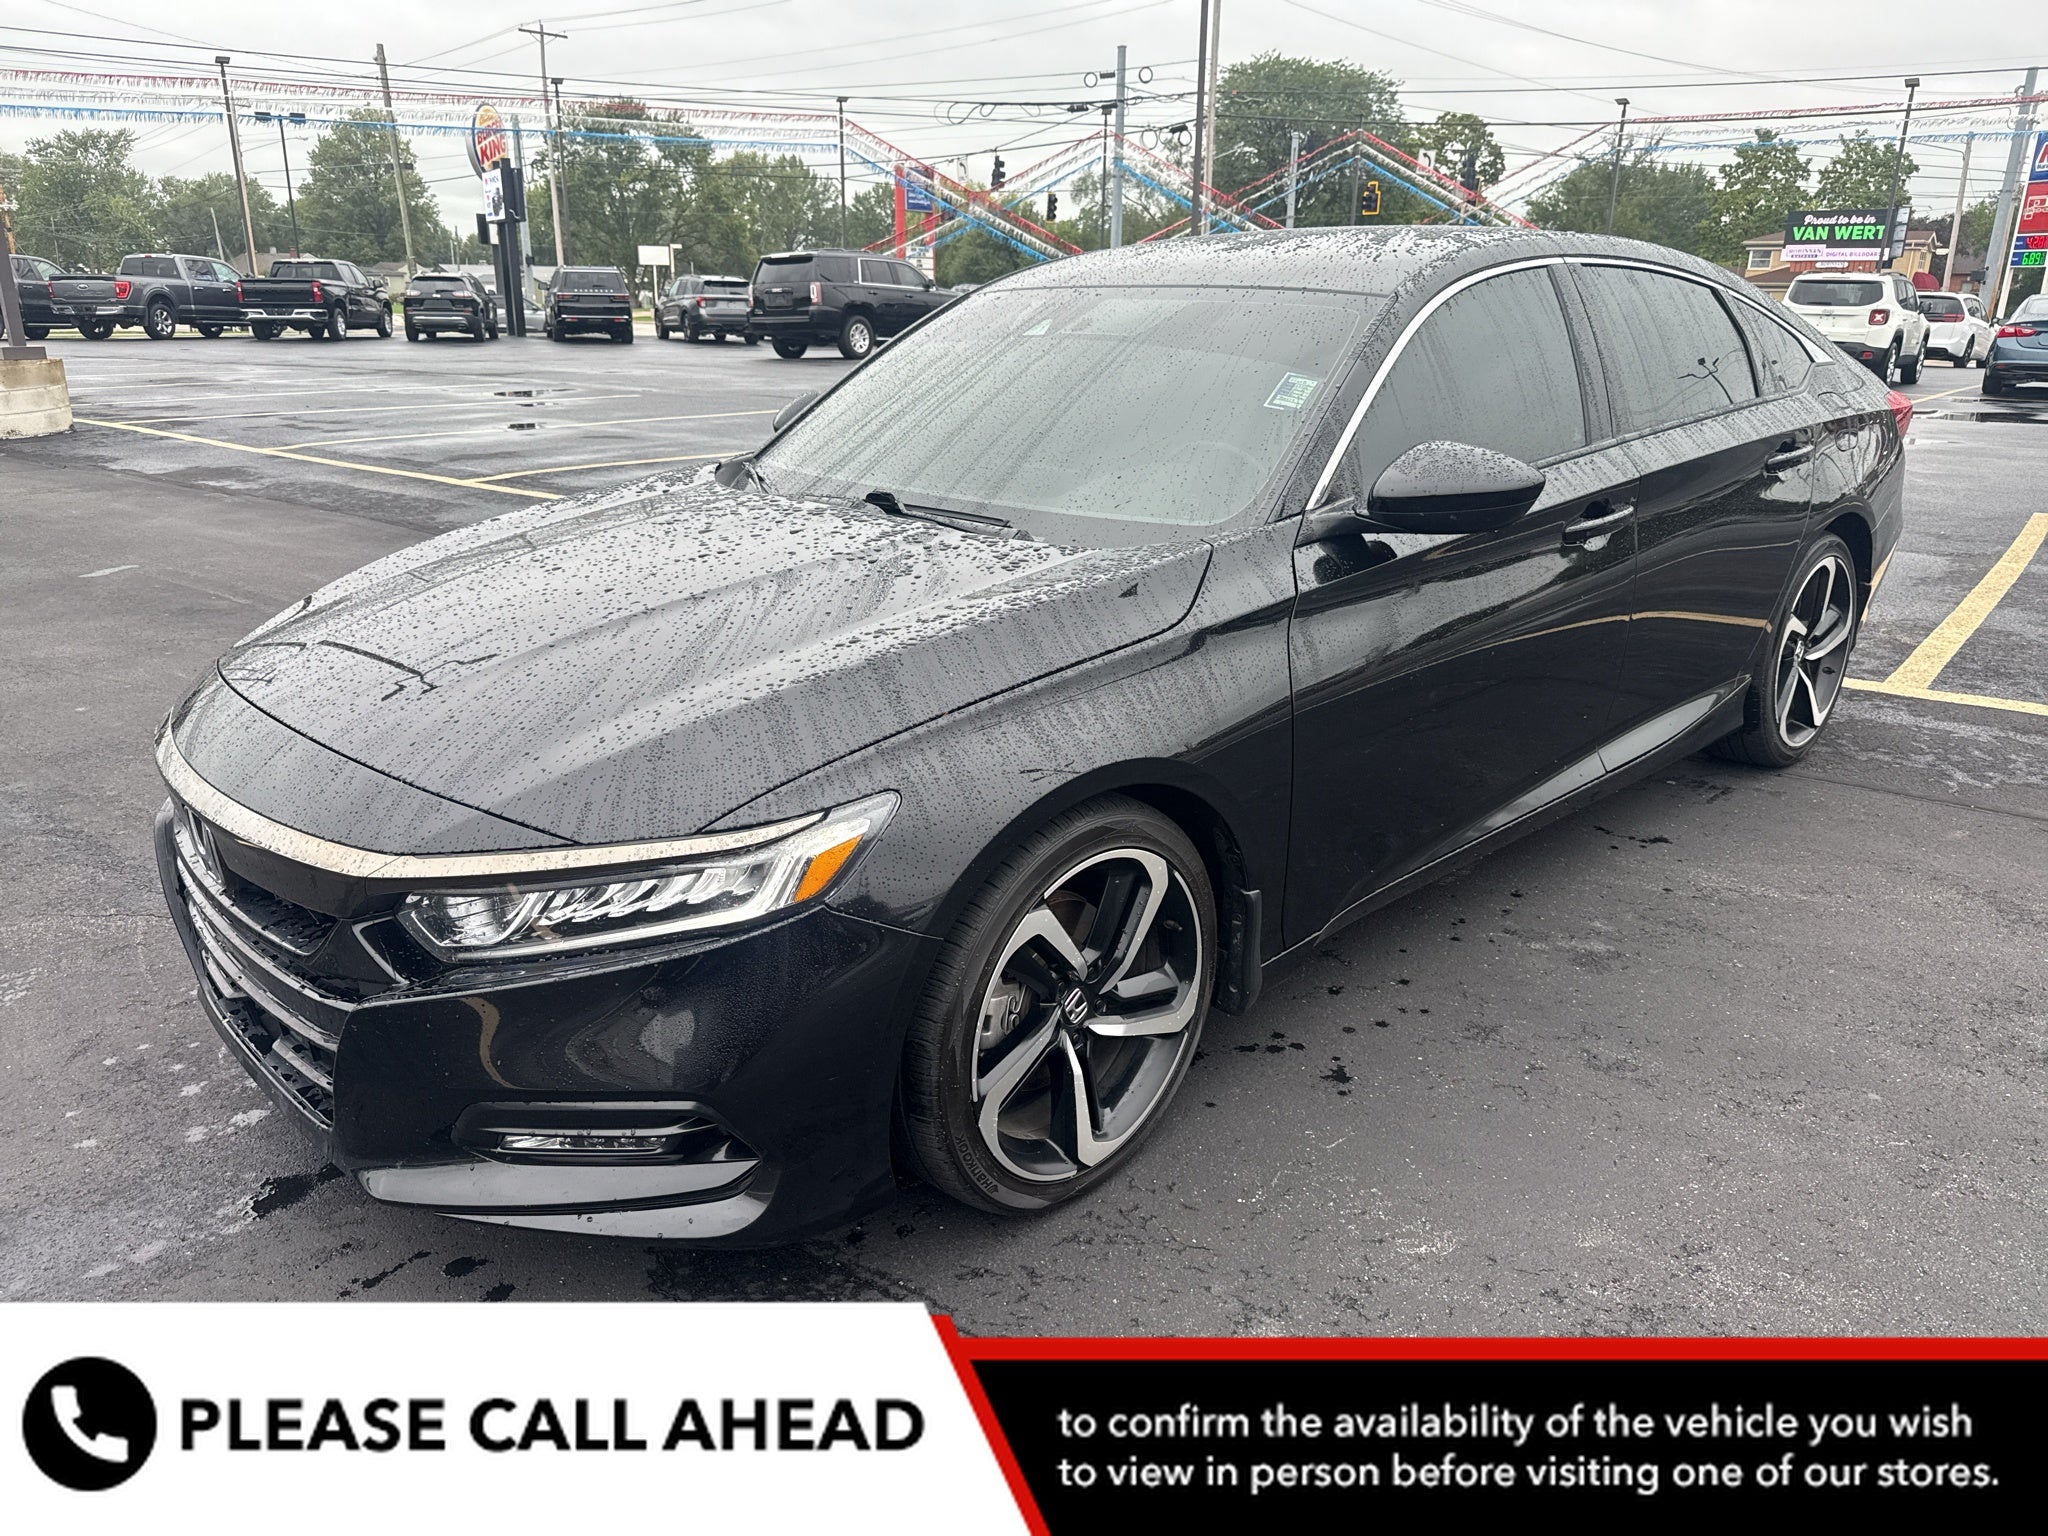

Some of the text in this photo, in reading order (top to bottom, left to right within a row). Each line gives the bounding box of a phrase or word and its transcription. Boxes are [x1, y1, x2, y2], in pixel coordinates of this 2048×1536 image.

[479, 133, 506, 165] KING
[1804, 214, 1876, 225] Proud to be in
[1793, 225, 1886, 241] VAN WERT
